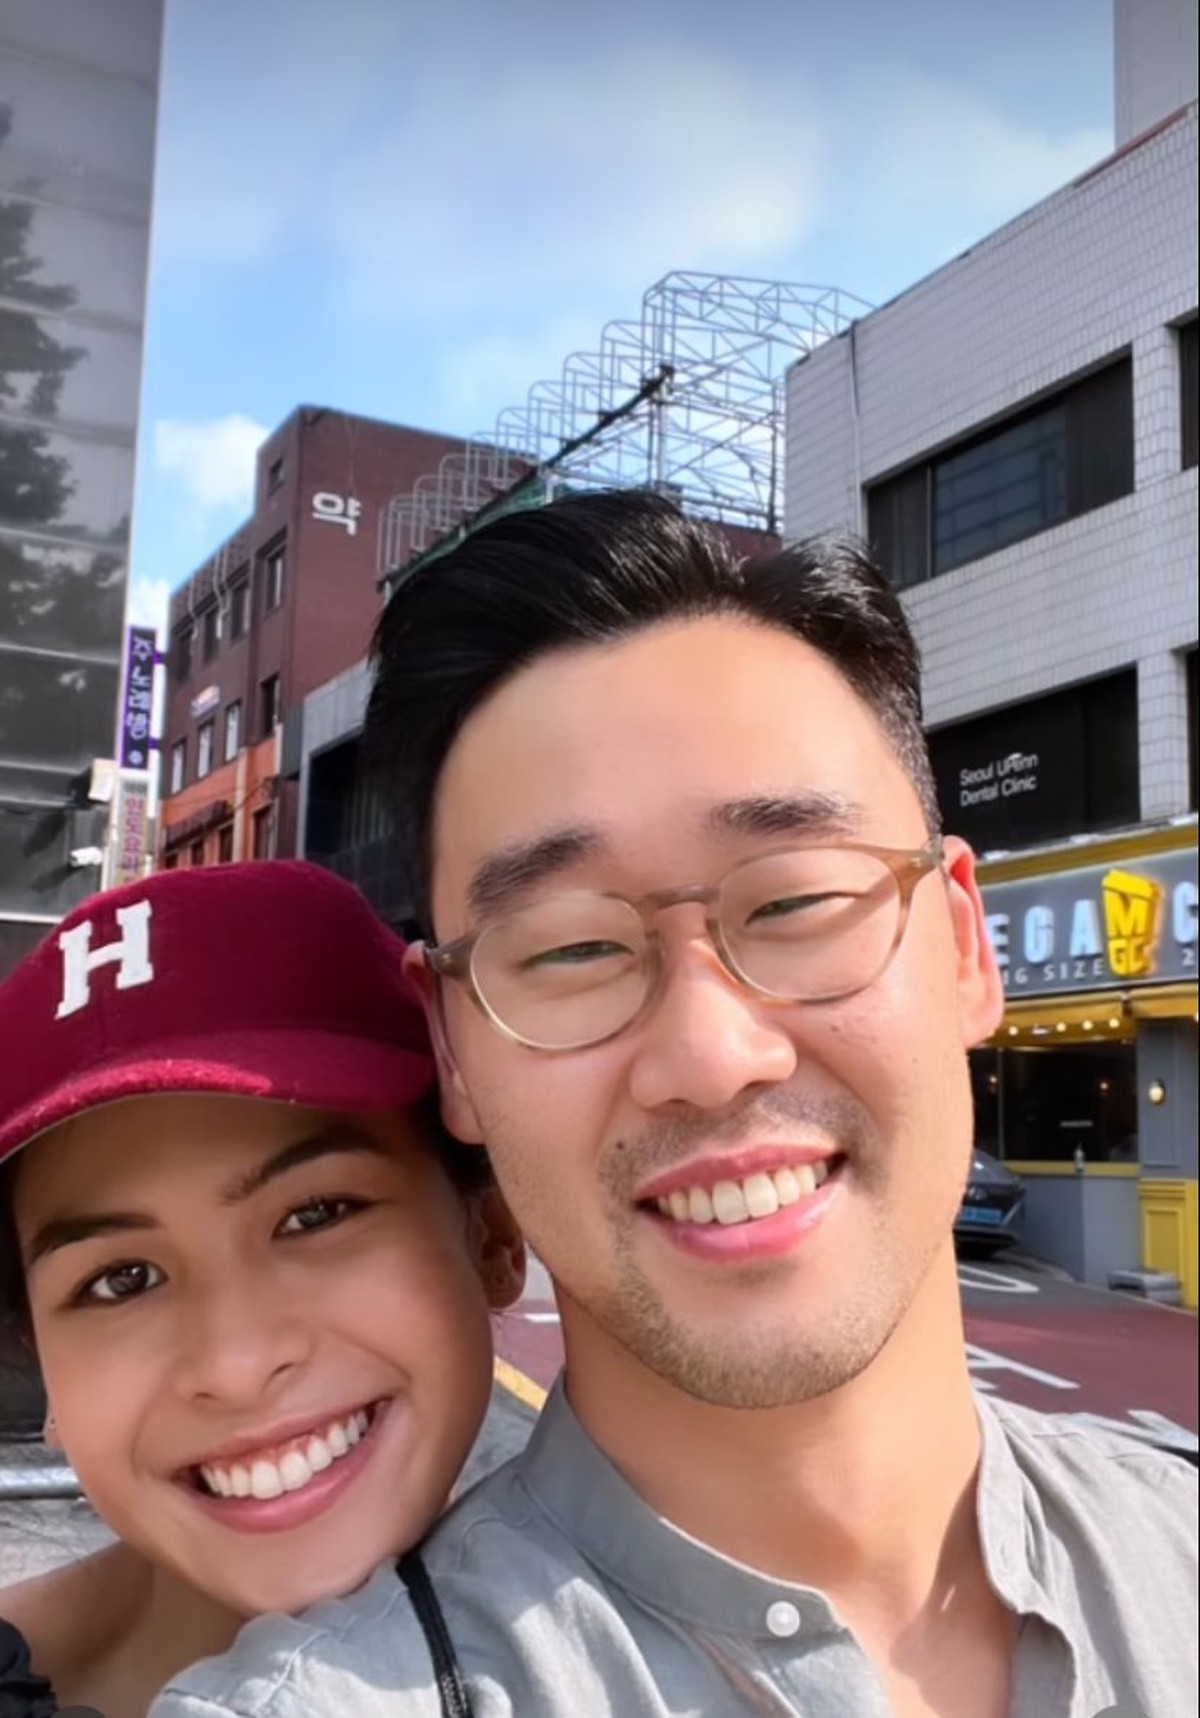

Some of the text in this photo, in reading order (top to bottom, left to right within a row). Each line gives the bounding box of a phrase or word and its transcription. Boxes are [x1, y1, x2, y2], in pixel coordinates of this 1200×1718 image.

[312, 491, 362, 537] 약
[960, 761, 994, 787] Seoul
[960, 774, 1038, 807] Dental Clinic
[54, 898, 154, 1020] H
[1043, 958, 1105, 982] SIZE
